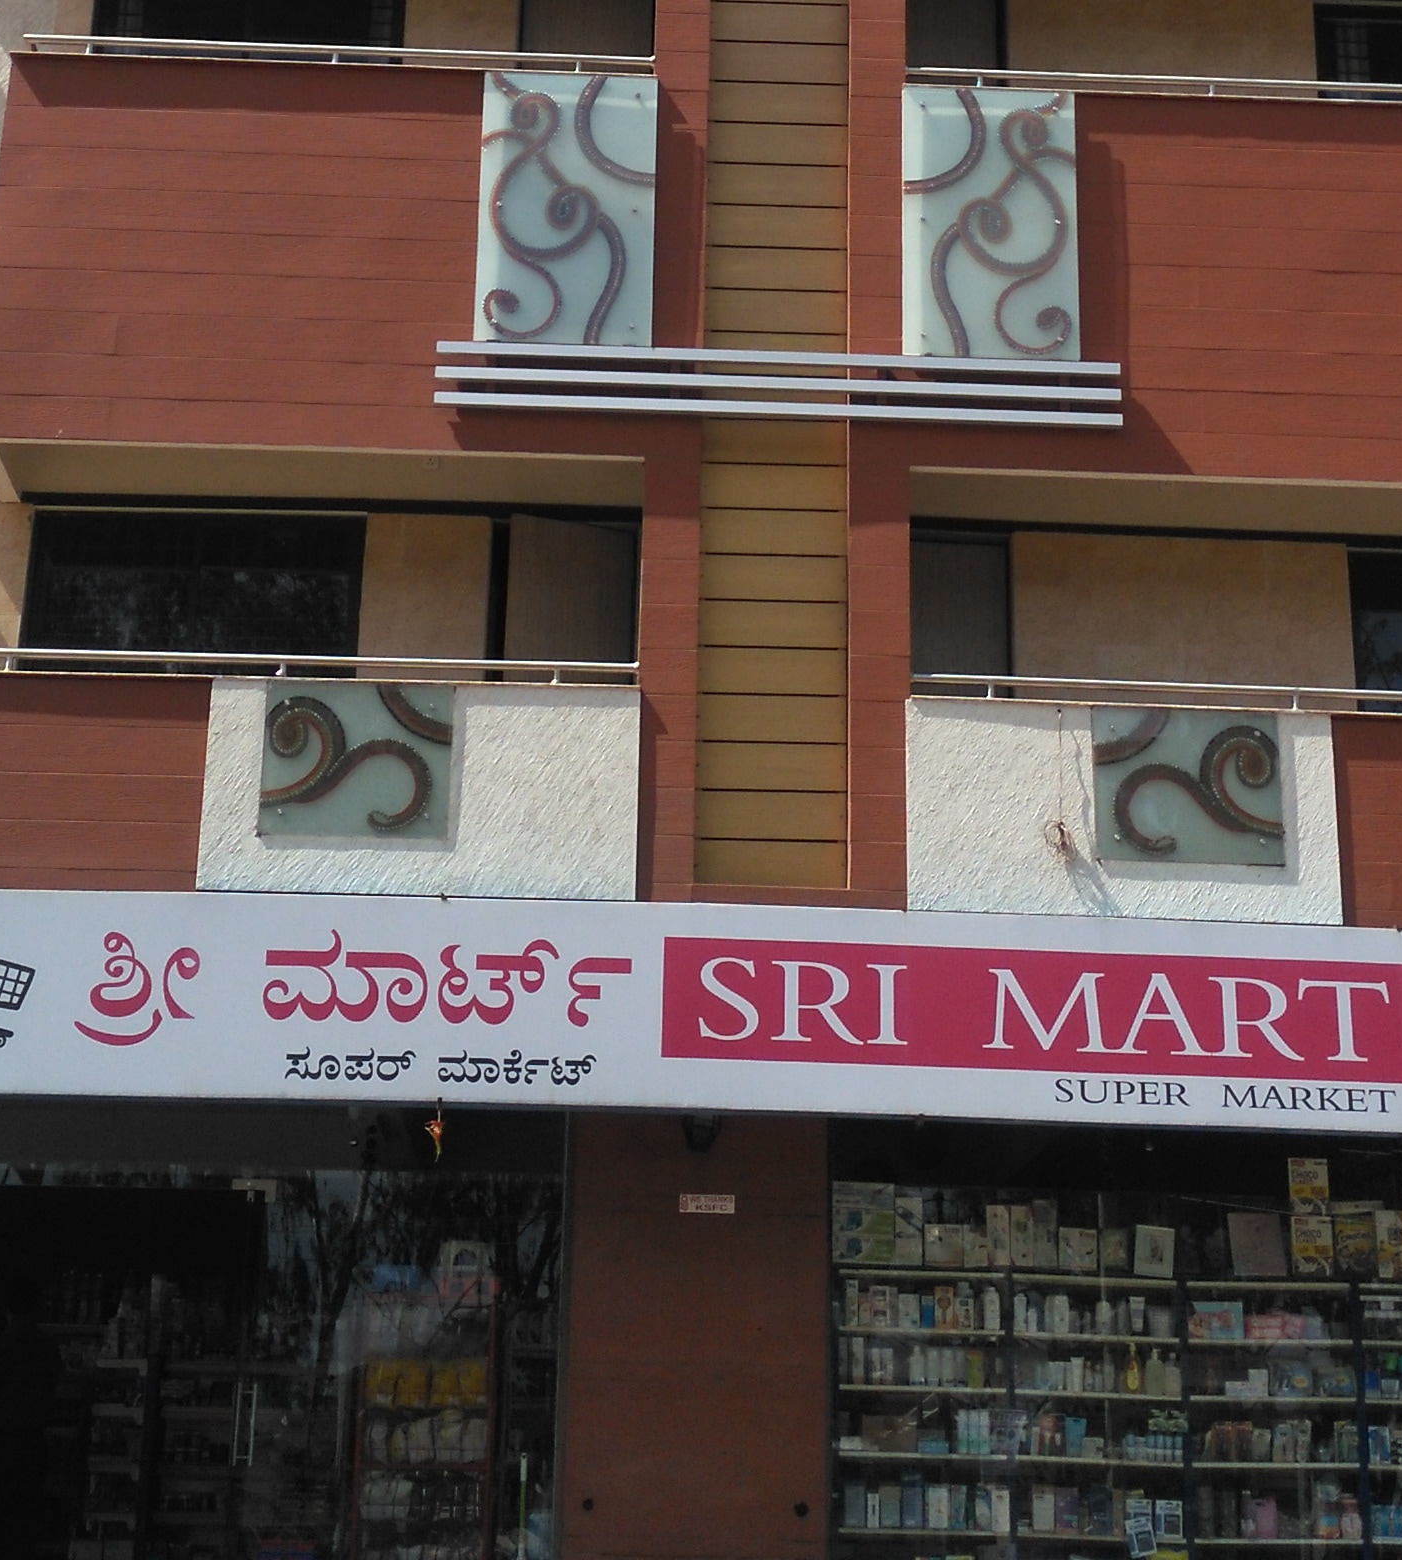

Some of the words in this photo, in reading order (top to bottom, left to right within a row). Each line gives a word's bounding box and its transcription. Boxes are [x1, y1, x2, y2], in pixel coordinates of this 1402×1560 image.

[75, 931, 200, 1046] ಶ್ರೀ
[264, 929, 632, 1027] ಮಾರ್ಟ್
[698, 956, 908, 1046] SRI
[982, 968, 1390, 1063] MART
[285, 1047, 416, 1082] ಸೂಪರ್
[1055, 1078, 1190, 1107] SUPER
[1222, 1083, 1397, 1115] MARKET
